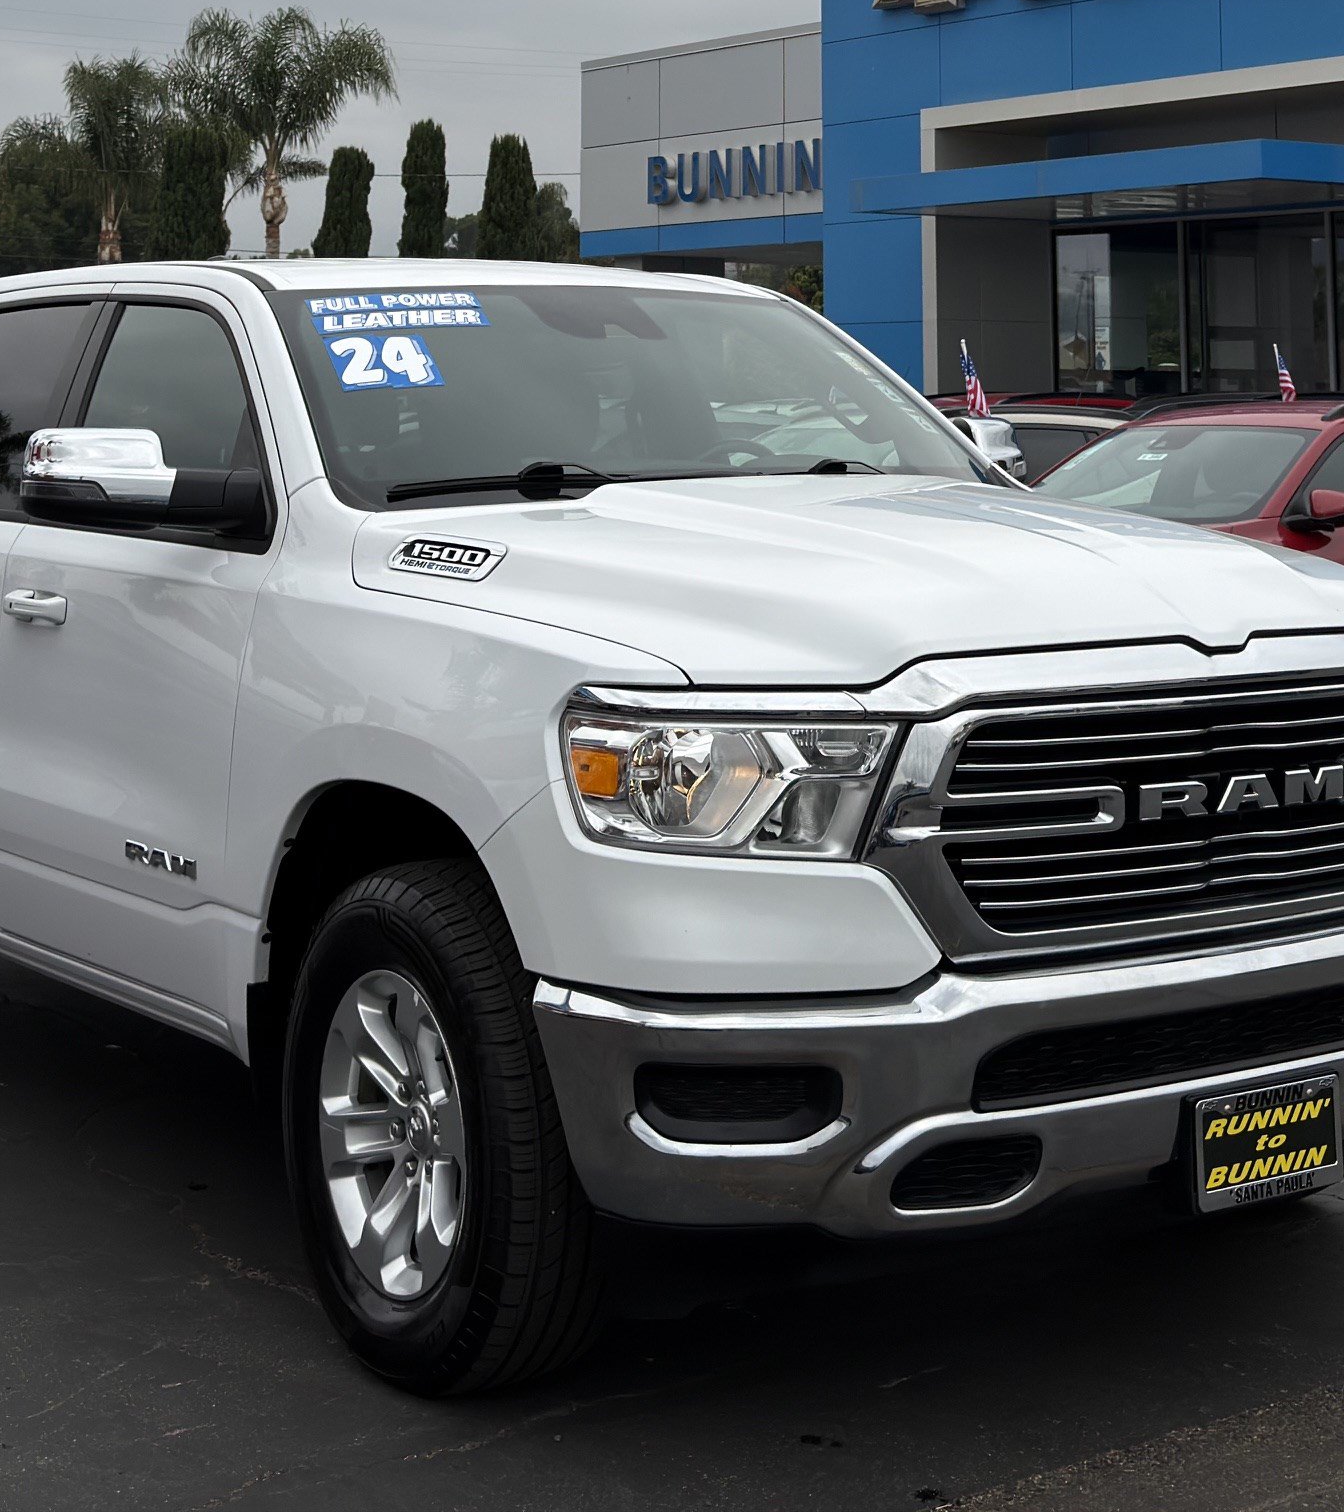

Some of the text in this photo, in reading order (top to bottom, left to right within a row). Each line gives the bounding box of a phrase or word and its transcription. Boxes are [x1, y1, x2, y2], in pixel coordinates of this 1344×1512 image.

[647, 138, 822, 205] BUNNIN
[310, 292, 479, 315] FULL POWER
[323, 309, 482, 331] LEATHER
[330, 336, 435, 386] 24
[400, 557, 427, 569] HEMI
[412, 542, 486, 565] 1500
[1139, 764, 1344, 821] RAM
[125, 839, 198, 881] RAM
[1235, 1083, 1304, 1112] BUNNIN
[1205, 1097, 1331, 1140] RUNNIN'
[1255, 1133, 1287, 1151] to
[1206, 1144, 1328, 1189] BUNNIN
